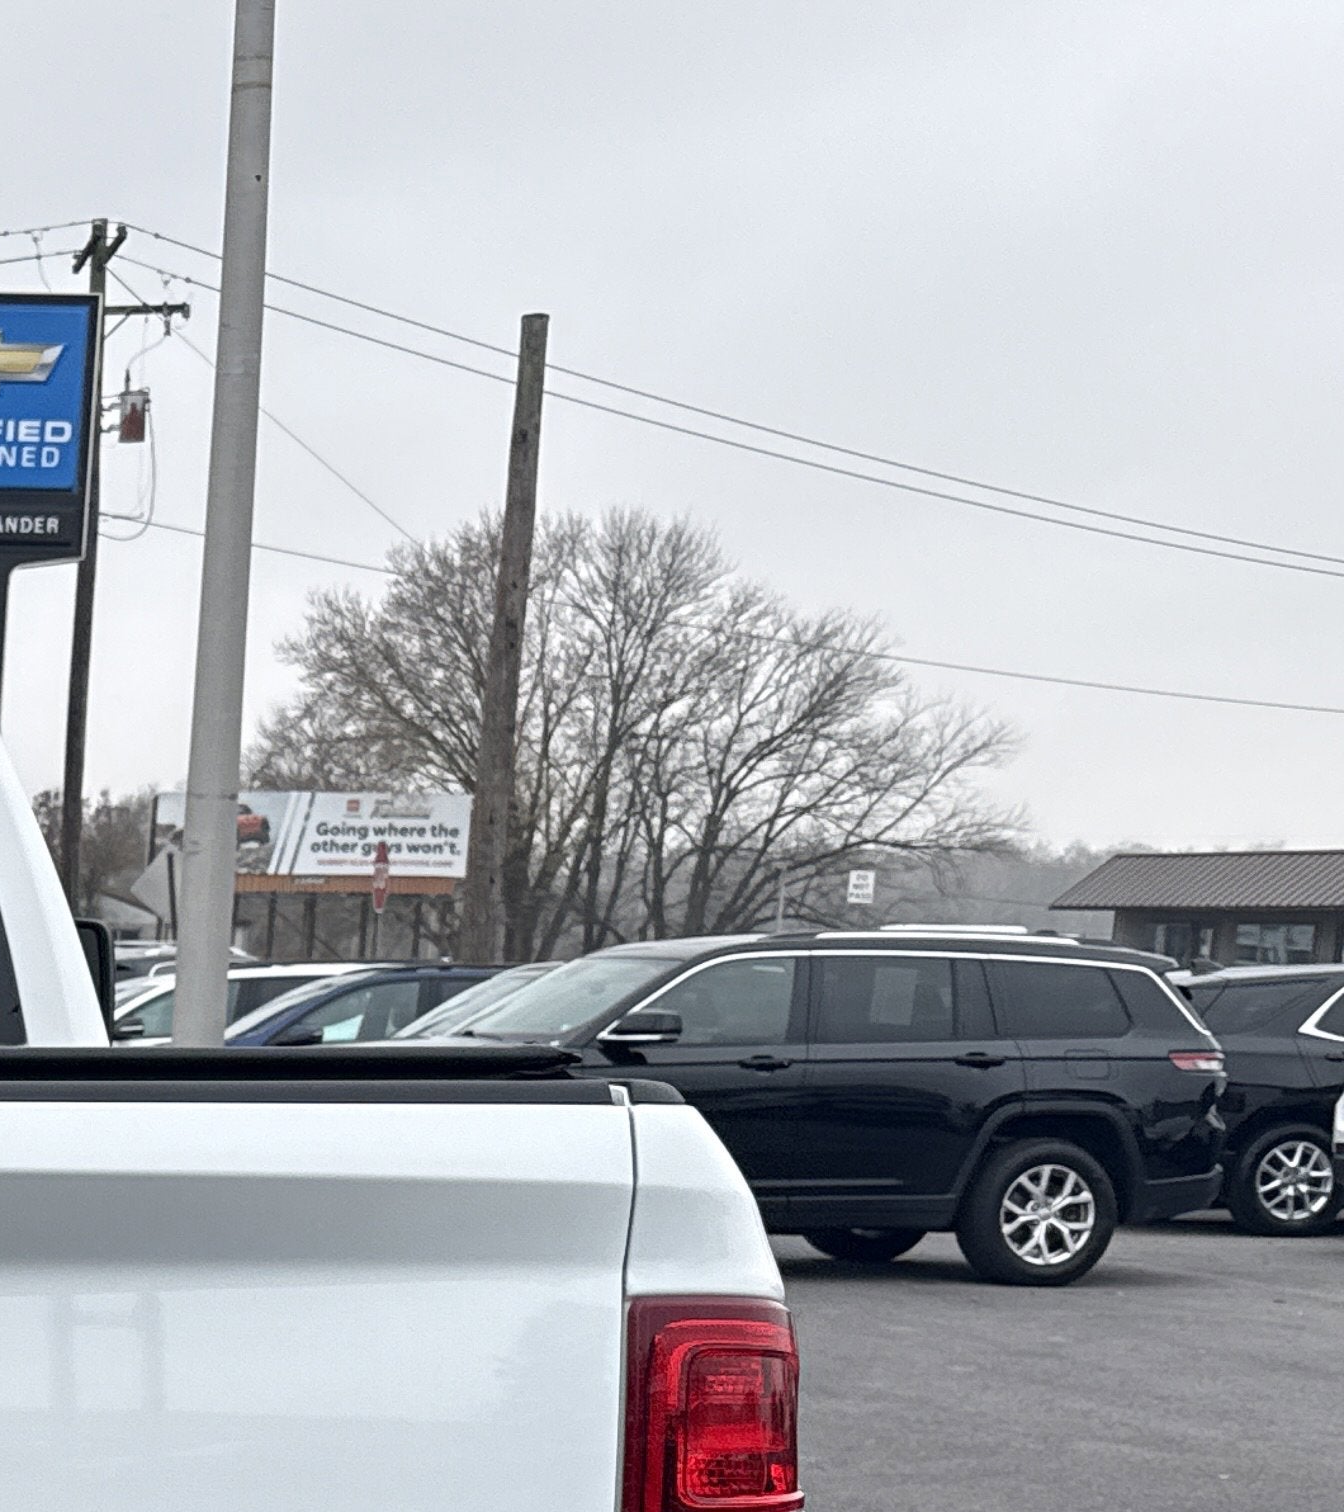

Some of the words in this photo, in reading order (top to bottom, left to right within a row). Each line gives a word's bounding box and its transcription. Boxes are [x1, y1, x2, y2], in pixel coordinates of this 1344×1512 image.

[316, 821, 369, 840] Going
[372, 822, 427, 838] where
[430, 823, 460, 838] the
[310, 840, 358, 853] other
[362, 842, 402, 857] gys
